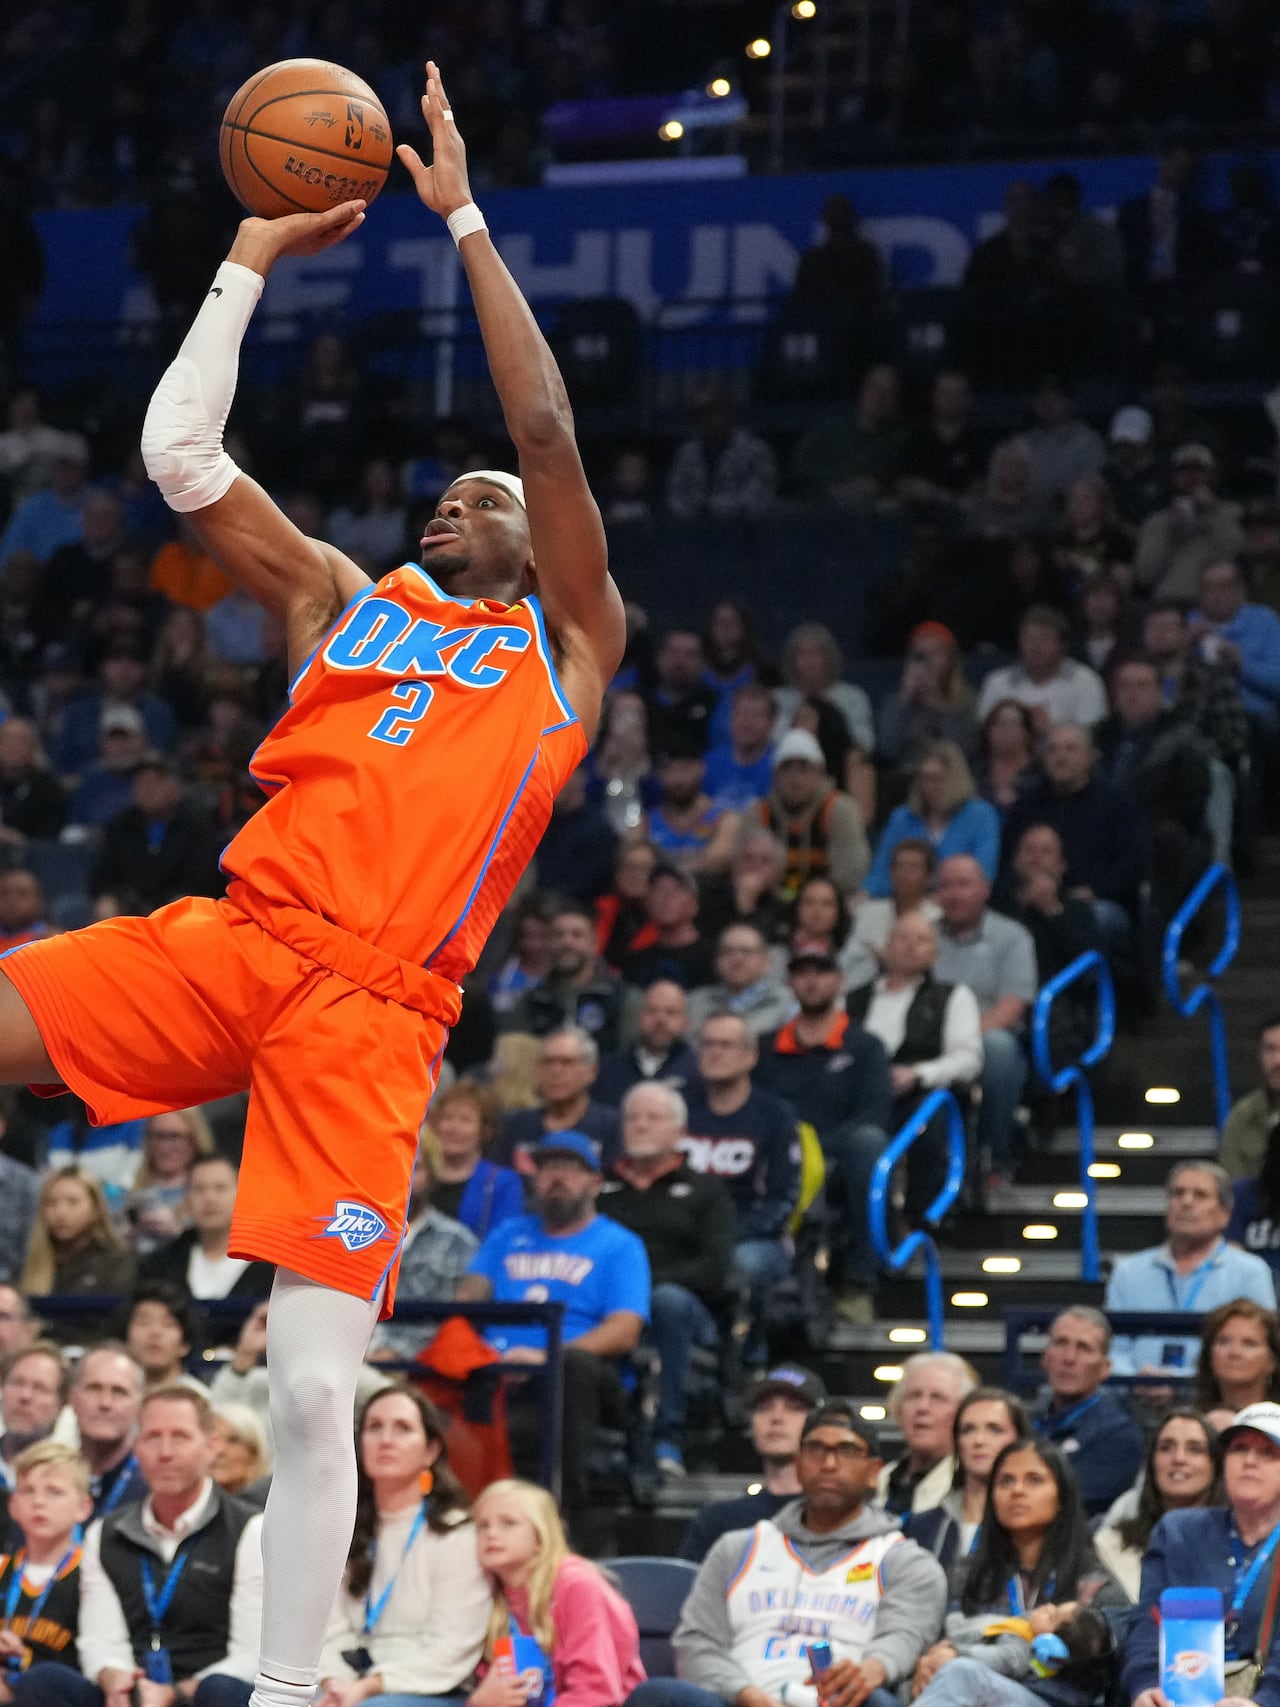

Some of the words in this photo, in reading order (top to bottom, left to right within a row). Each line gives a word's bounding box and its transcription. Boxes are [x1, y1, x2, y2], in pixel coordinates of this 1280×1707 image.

[322, 597, 532, 689] OKC
[367, 679, 435, 747] 2
[326, 1214, 377, 1232] OKC
